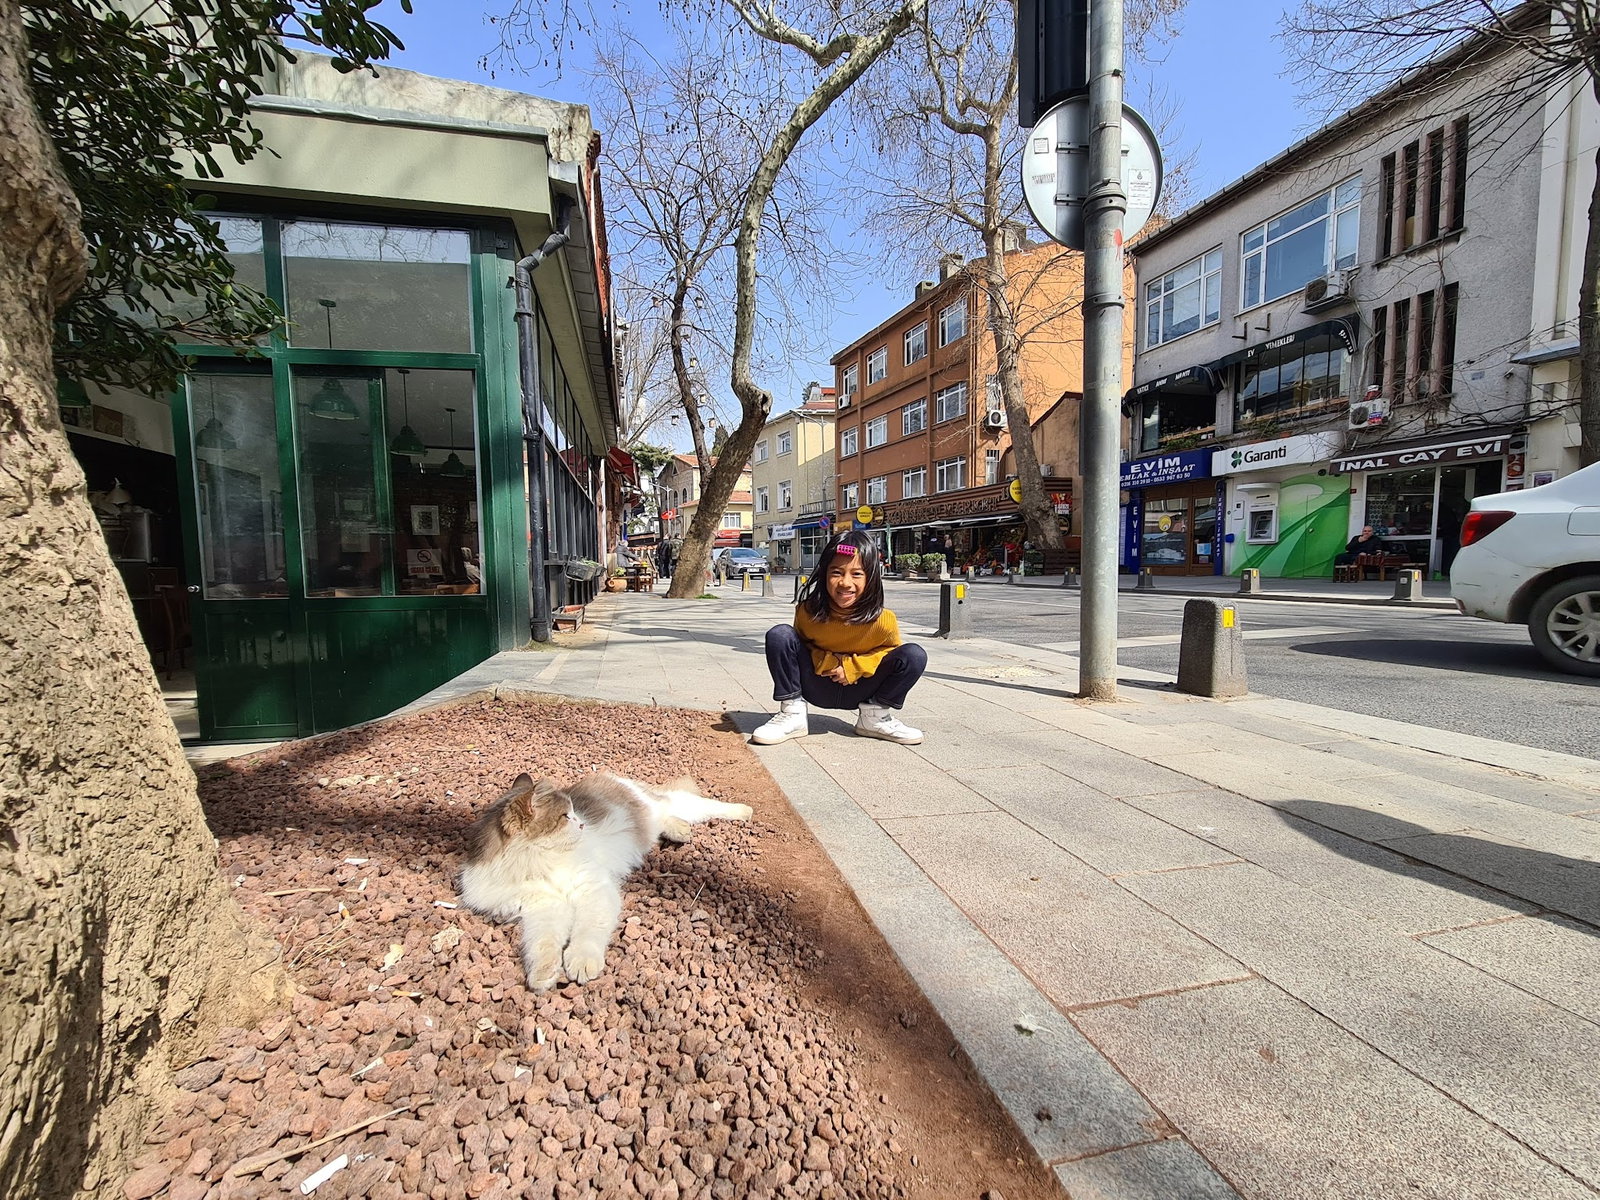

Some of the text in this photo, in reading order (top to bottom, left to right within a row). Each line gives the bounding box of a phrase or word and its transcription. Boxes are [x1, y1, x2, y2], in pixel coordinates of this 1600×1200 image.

[1244, 445, 1287, 463] Garanti
[1339, 440, 1502, 472] İNAL ÇAY EVİ
[1130, 457, 1180, 473] EVİM
[1120, 472, 1150, 482] EMLAK
